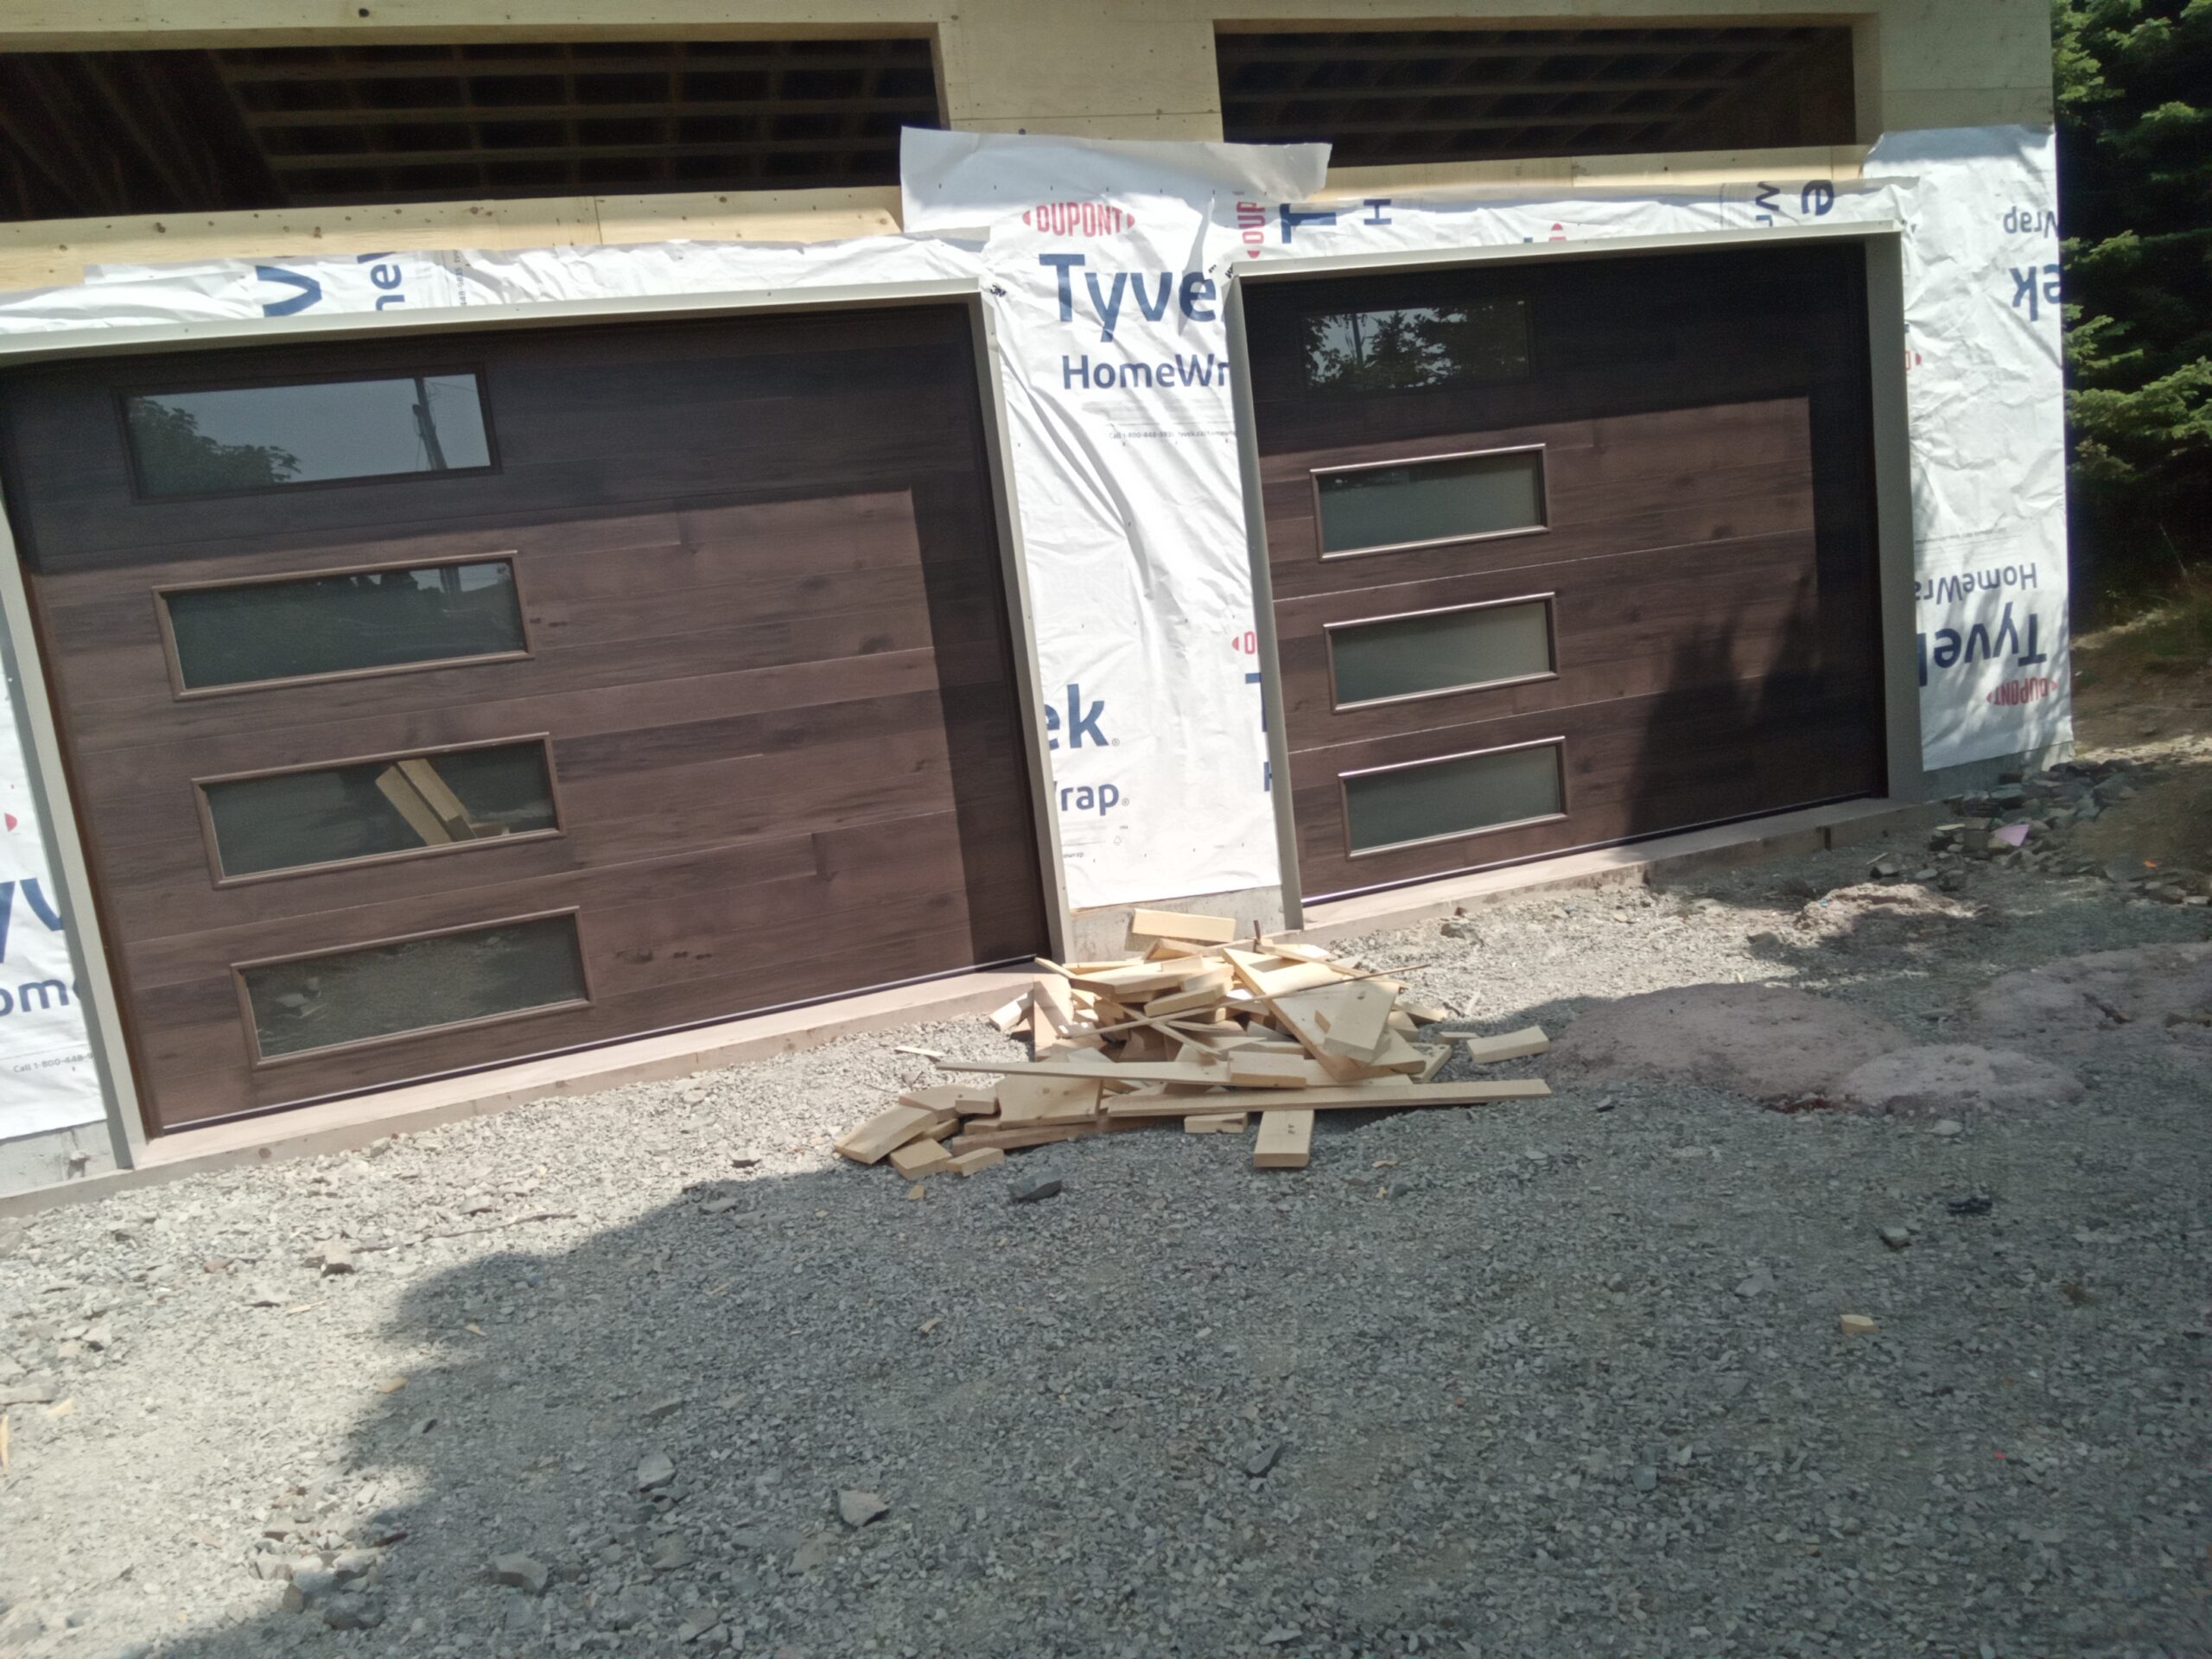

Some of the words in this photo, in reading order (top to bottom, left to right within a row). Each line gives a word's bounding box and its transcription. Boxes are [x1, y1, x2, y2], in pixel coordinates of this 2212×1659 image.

[1036, 201, 1123, 238] DUPONT
[1039, 253, 1217, 343] Tyve
[1061, 353, 1231, 391] HomeWr
[1993, 677, 2049, 707] DUPONT
[1053, 781, 1120, 817] rap
[13, 1063, 32, 1073] Call
